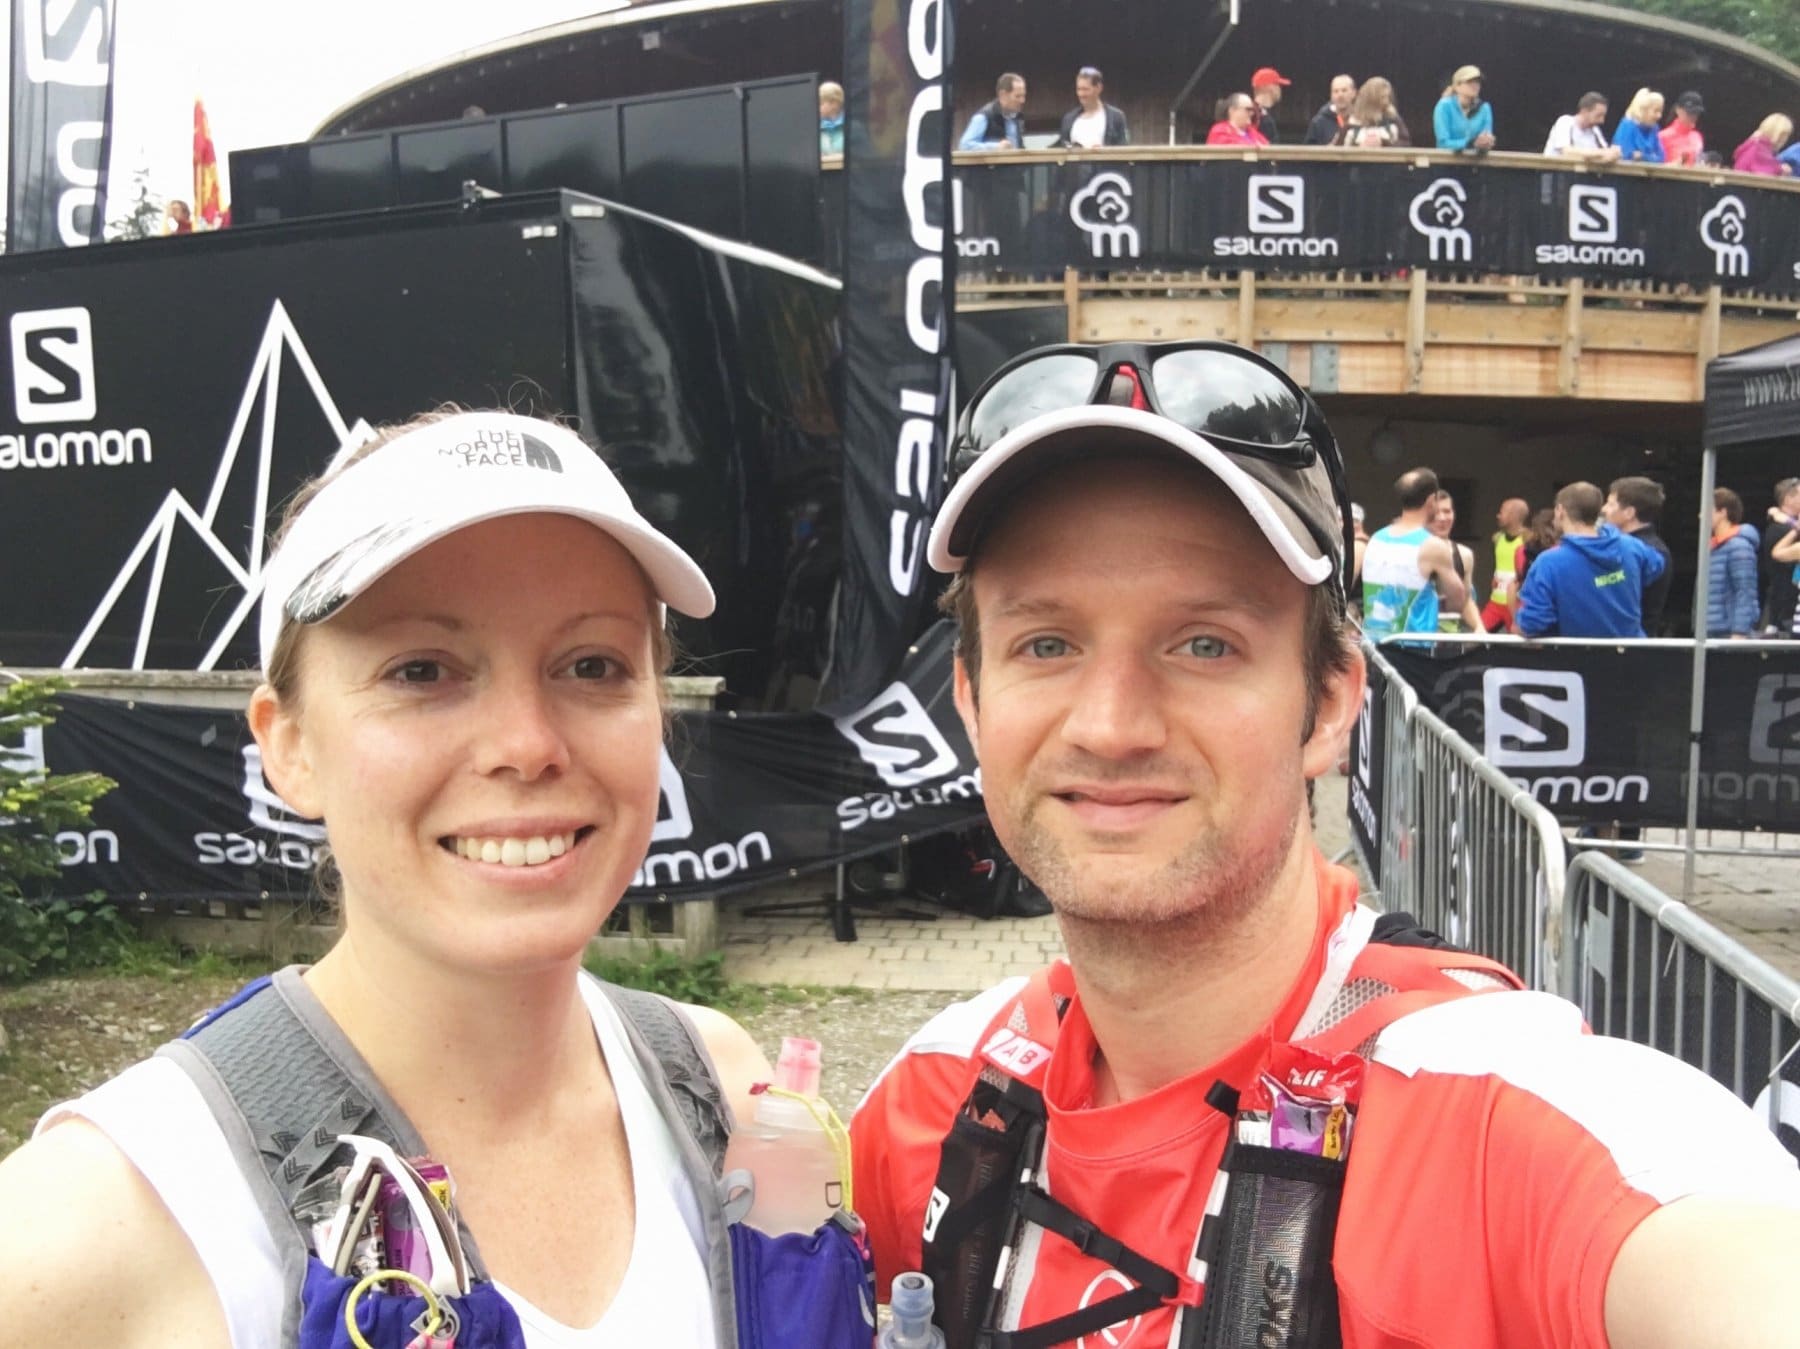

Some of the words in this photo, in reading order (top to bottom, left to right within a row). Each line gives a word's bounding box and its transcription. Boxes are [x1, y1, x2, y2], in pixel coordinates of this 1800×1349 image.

[1212, 236, 1339, 257] salomon
[1535, 244, 1645, 267] salomon
[477, 429, 521, 443] THE
[438, 440, 522, 457] NORTH
[464, 453, 524, 467] FACE
